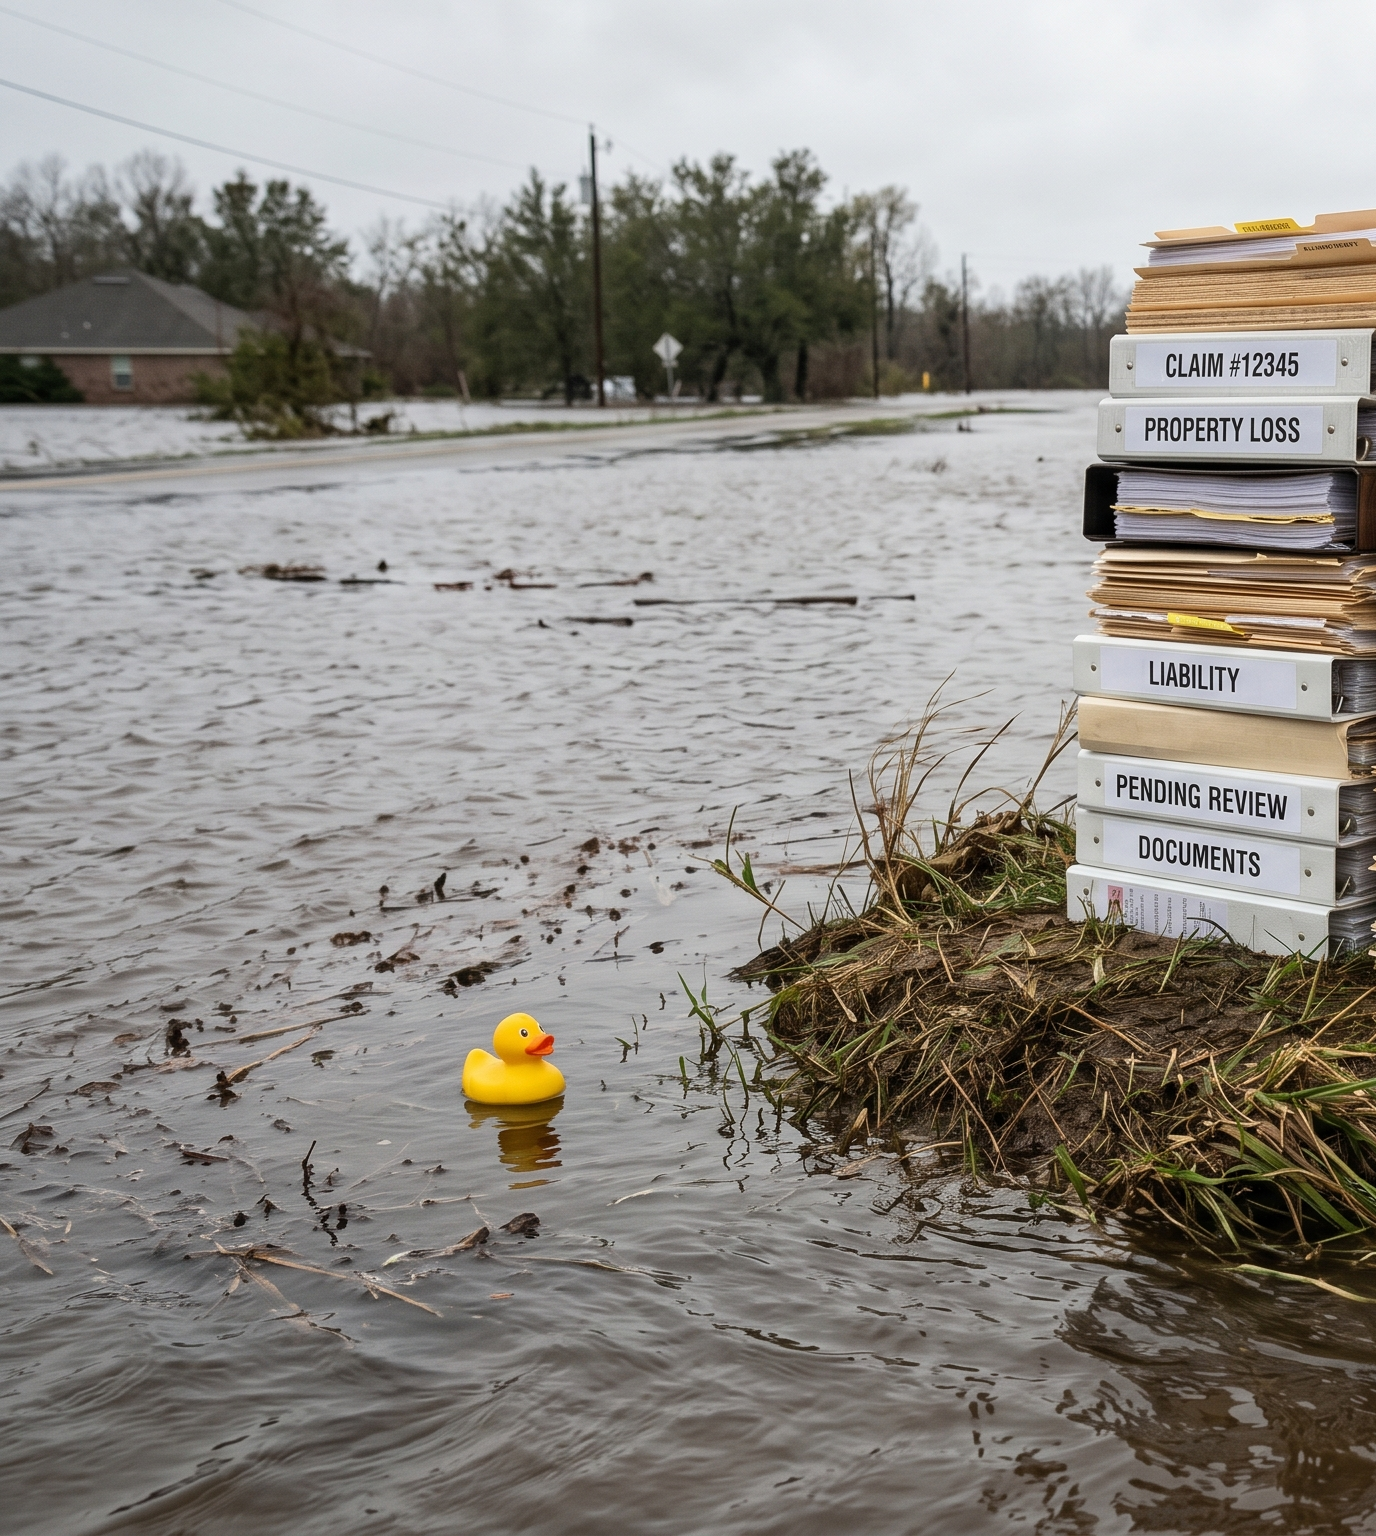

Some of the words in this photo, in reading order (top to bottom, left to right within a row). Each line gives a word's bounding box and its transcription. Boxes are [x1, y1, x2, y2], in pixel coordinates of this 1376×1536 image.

[1165, 353, 1224, 378] CLAIM
[1229, 352, 1299, 378] #12345
[1144, 417, 1244, 442] PROPERTY
[1250, 416, 1300, 443] LOSS
[1149, 661, 1240, 693] LIABILITY
[1116, 774, 1201, 809] PENDING
[1208, 786, 1288, 821] REVIEW
[1139, 835, 1261, 878] DOCUMENTS
